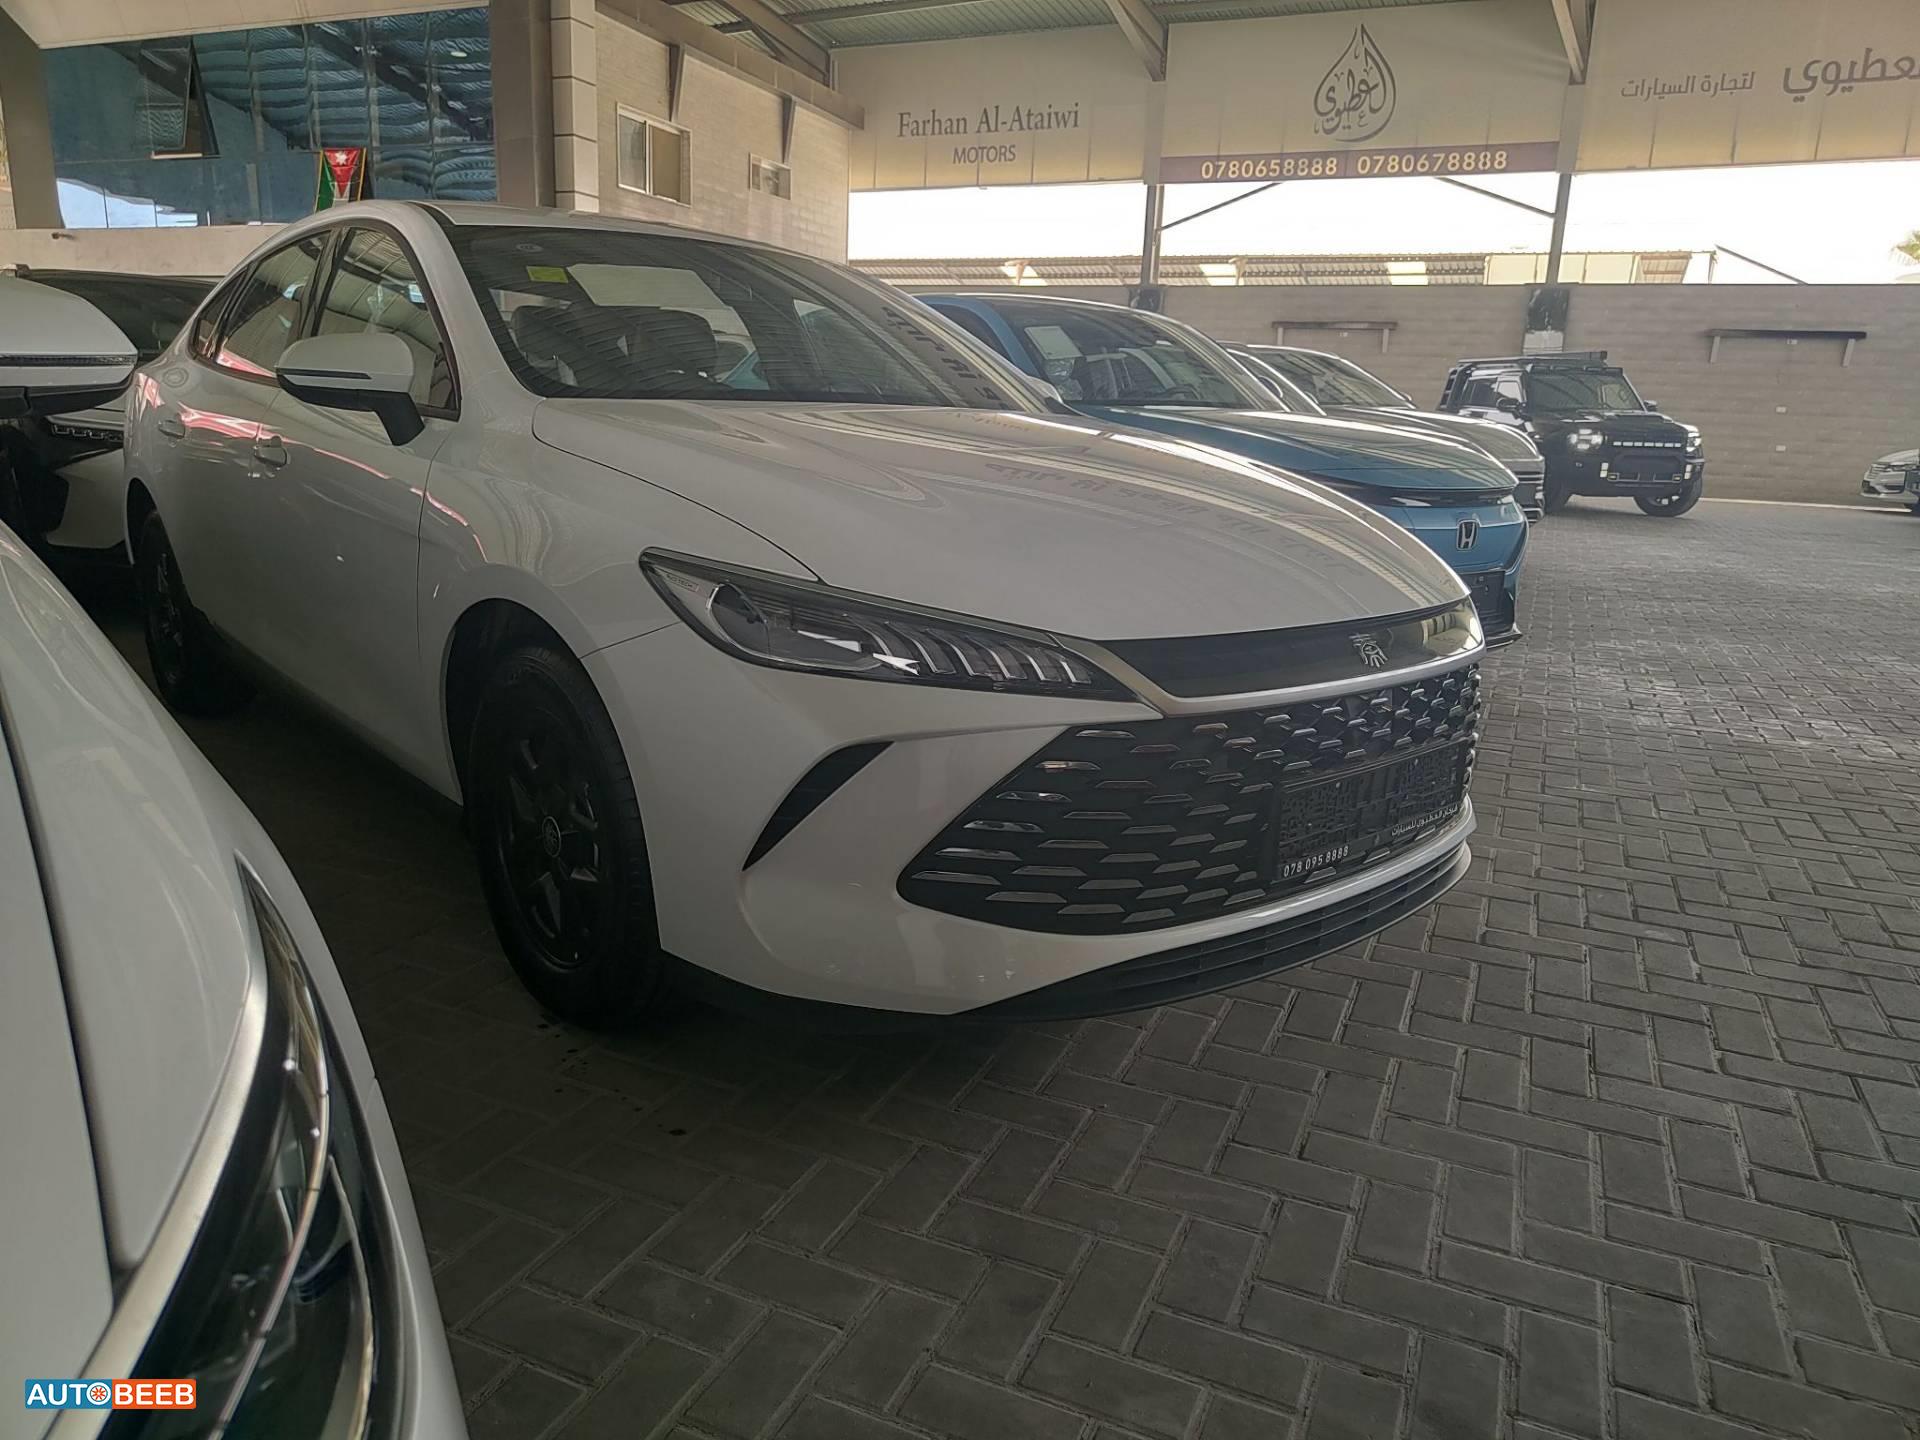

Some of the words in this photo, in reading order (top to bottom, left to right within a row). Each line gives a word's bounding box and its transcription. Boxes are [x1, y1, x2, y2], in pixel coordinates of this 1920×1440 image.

[1620, 75, 1697, 102] السيارات
[1700, 71, 1756, 99] لتجارة
[897, 108, 968, 138] Farhan
[975, 102, 1080, 134] Al-Ataiwi
[952, 144, 1017, 165] MOTORS
[1201, 157, 1338, 180] 0780658888
[1357, 150, 1508, 175] 0780678888
[1283, 861, 1303, 878] 078
[1305, 856, 1324, 870] 095
[1325, 845, 1349, 863] 8888
